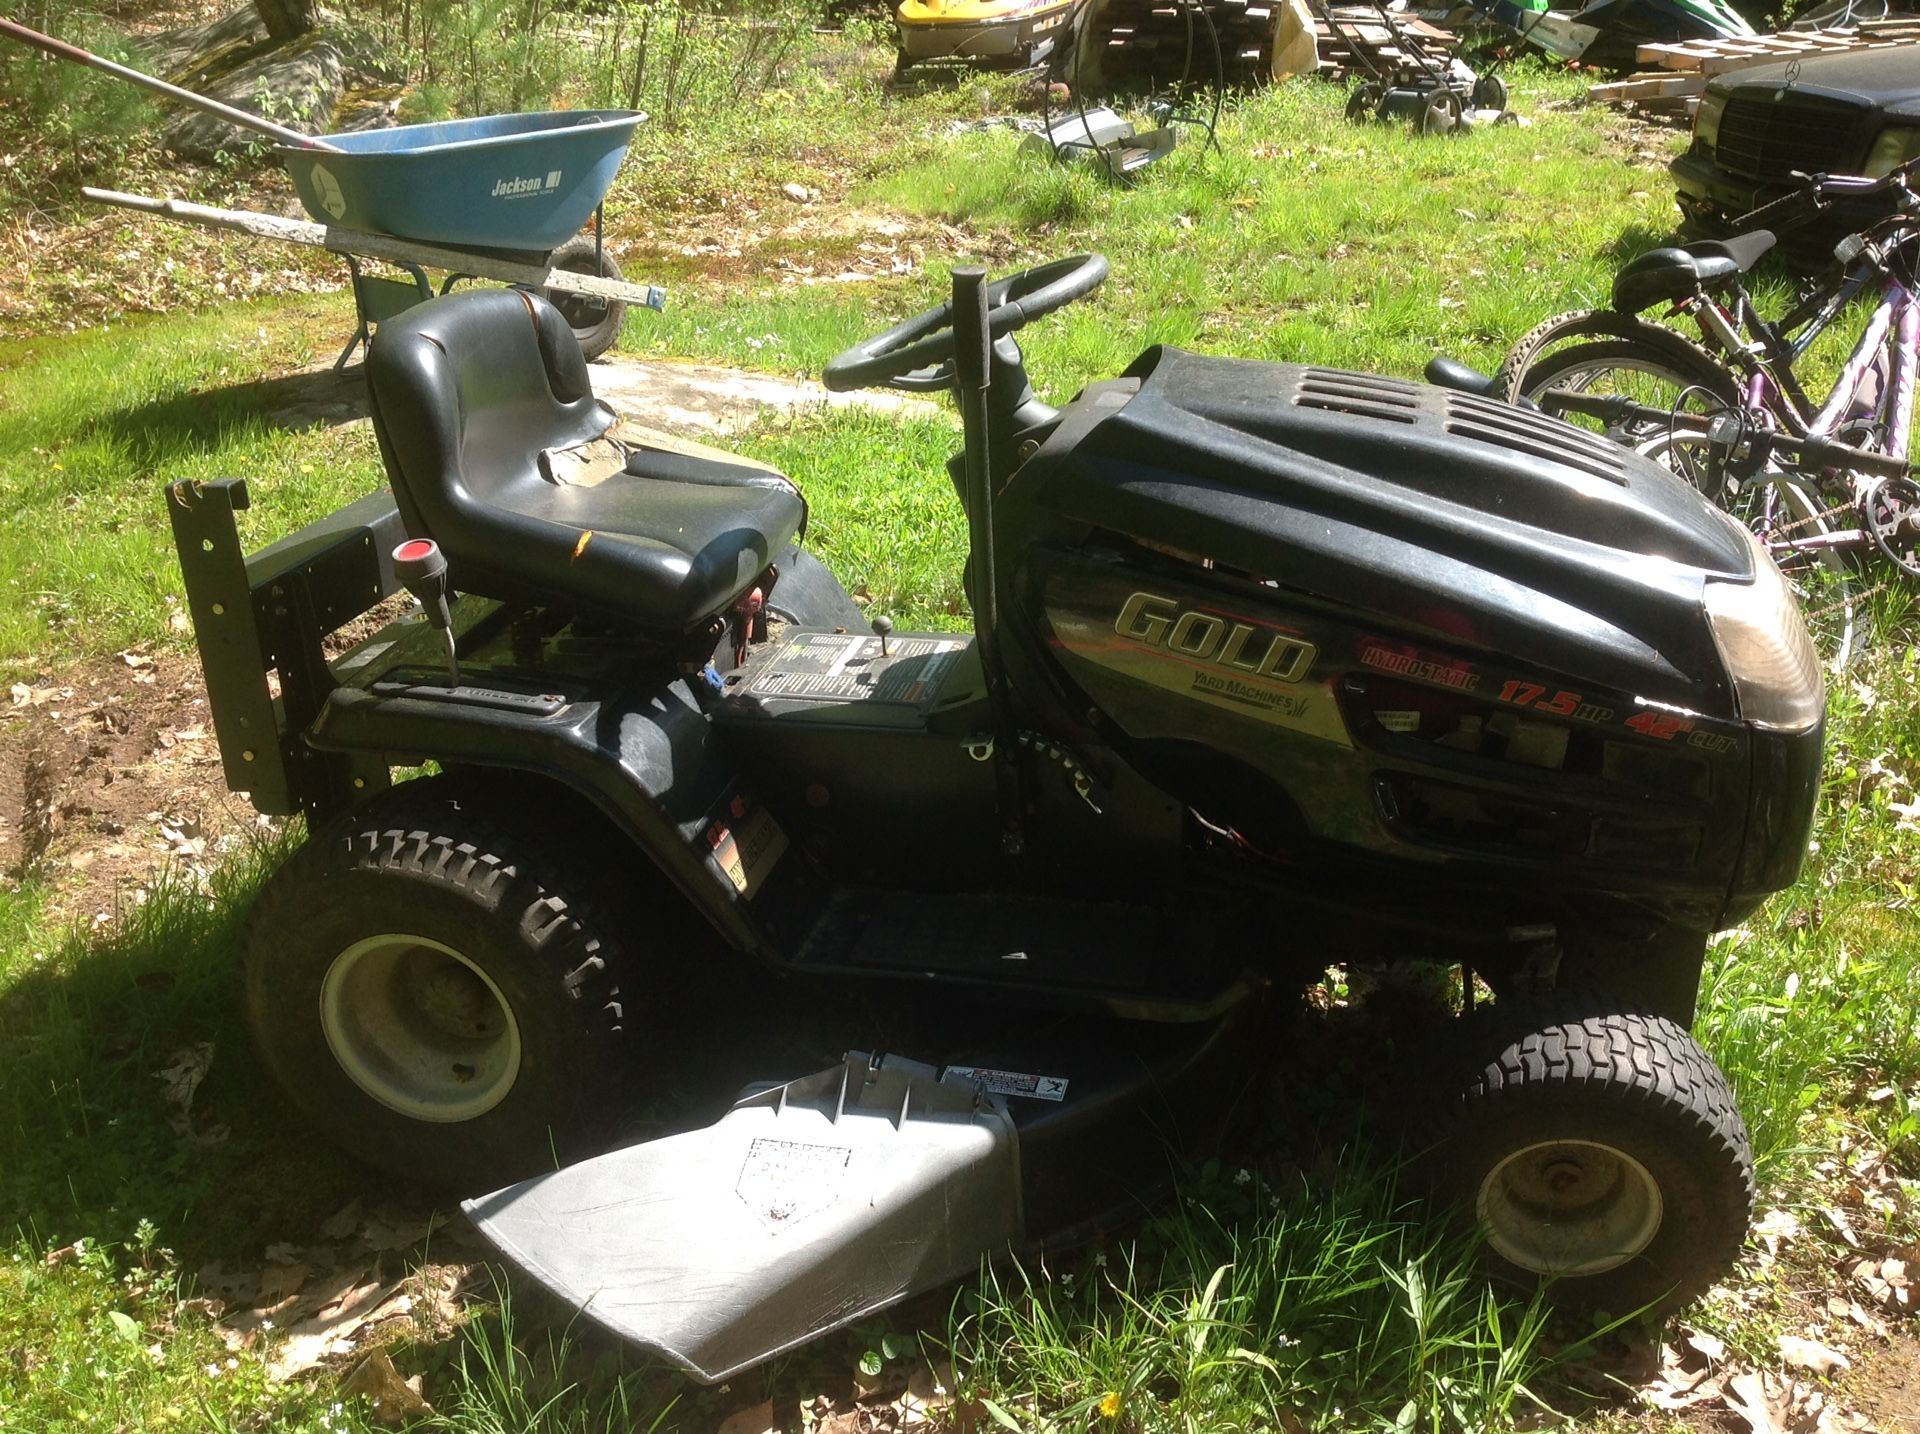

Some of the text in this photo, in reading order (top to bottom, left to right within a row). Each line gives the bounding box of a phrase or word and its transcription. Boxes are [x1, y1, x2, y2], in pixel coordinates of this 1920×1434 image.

[491, 177, 542, 197] Jackson
[1114, 592, 1320, 684] GOLD
[1193, 670, 1294, 709] YARD MACHINES
[1360, 646, 1480, 692] HYDROSTATIC
[1499, 680, 1583, 716] 17.5
[1573, 702, 1614, 724] HP
[1686, 730, 1738, 753] CUT
